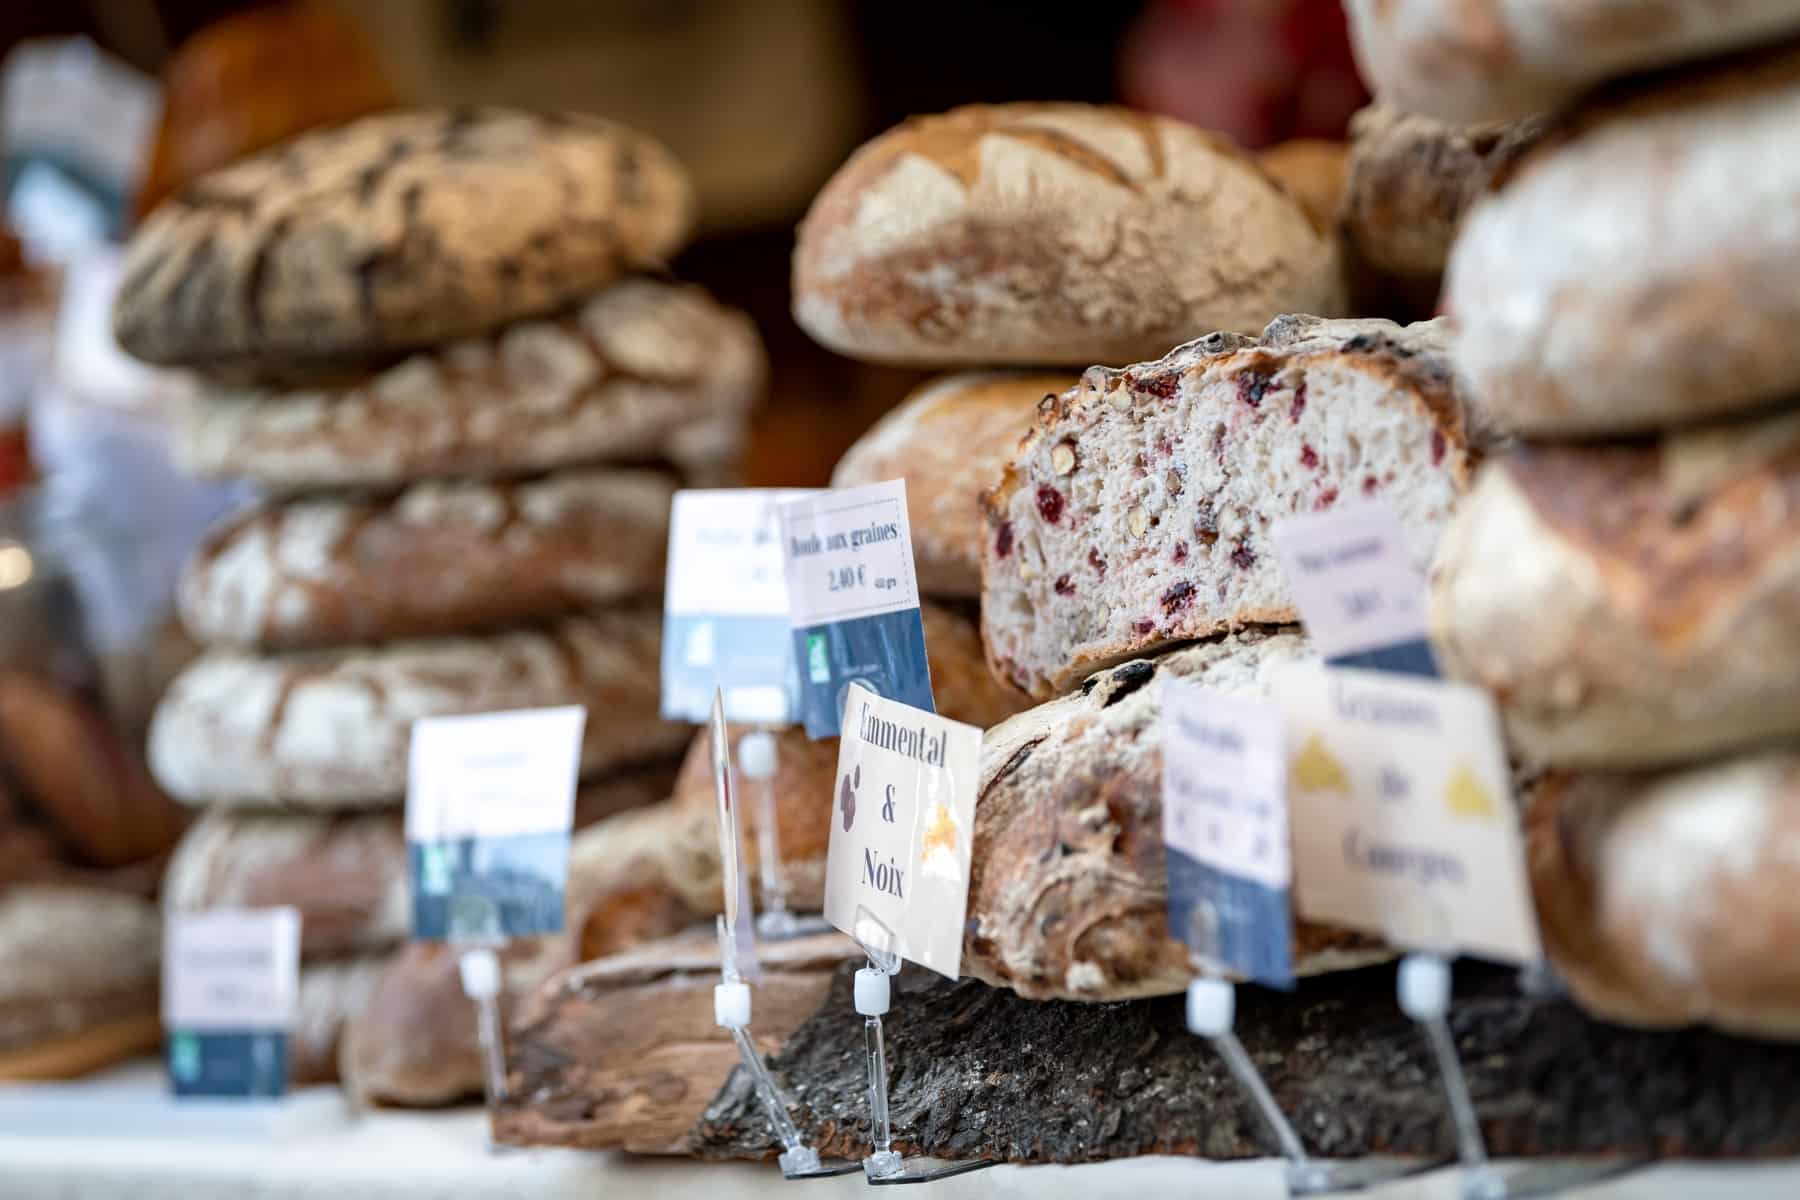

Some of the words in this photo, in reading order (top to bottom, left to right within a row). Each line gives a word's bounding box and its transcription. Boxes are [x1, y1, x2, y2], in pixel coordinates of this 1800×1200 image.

[850, 521, 898, 552] graines
[860, 702, 947, 768] Emmental
[882, 784, 896, 823] &
[861, 847, 904, 898] Noix
